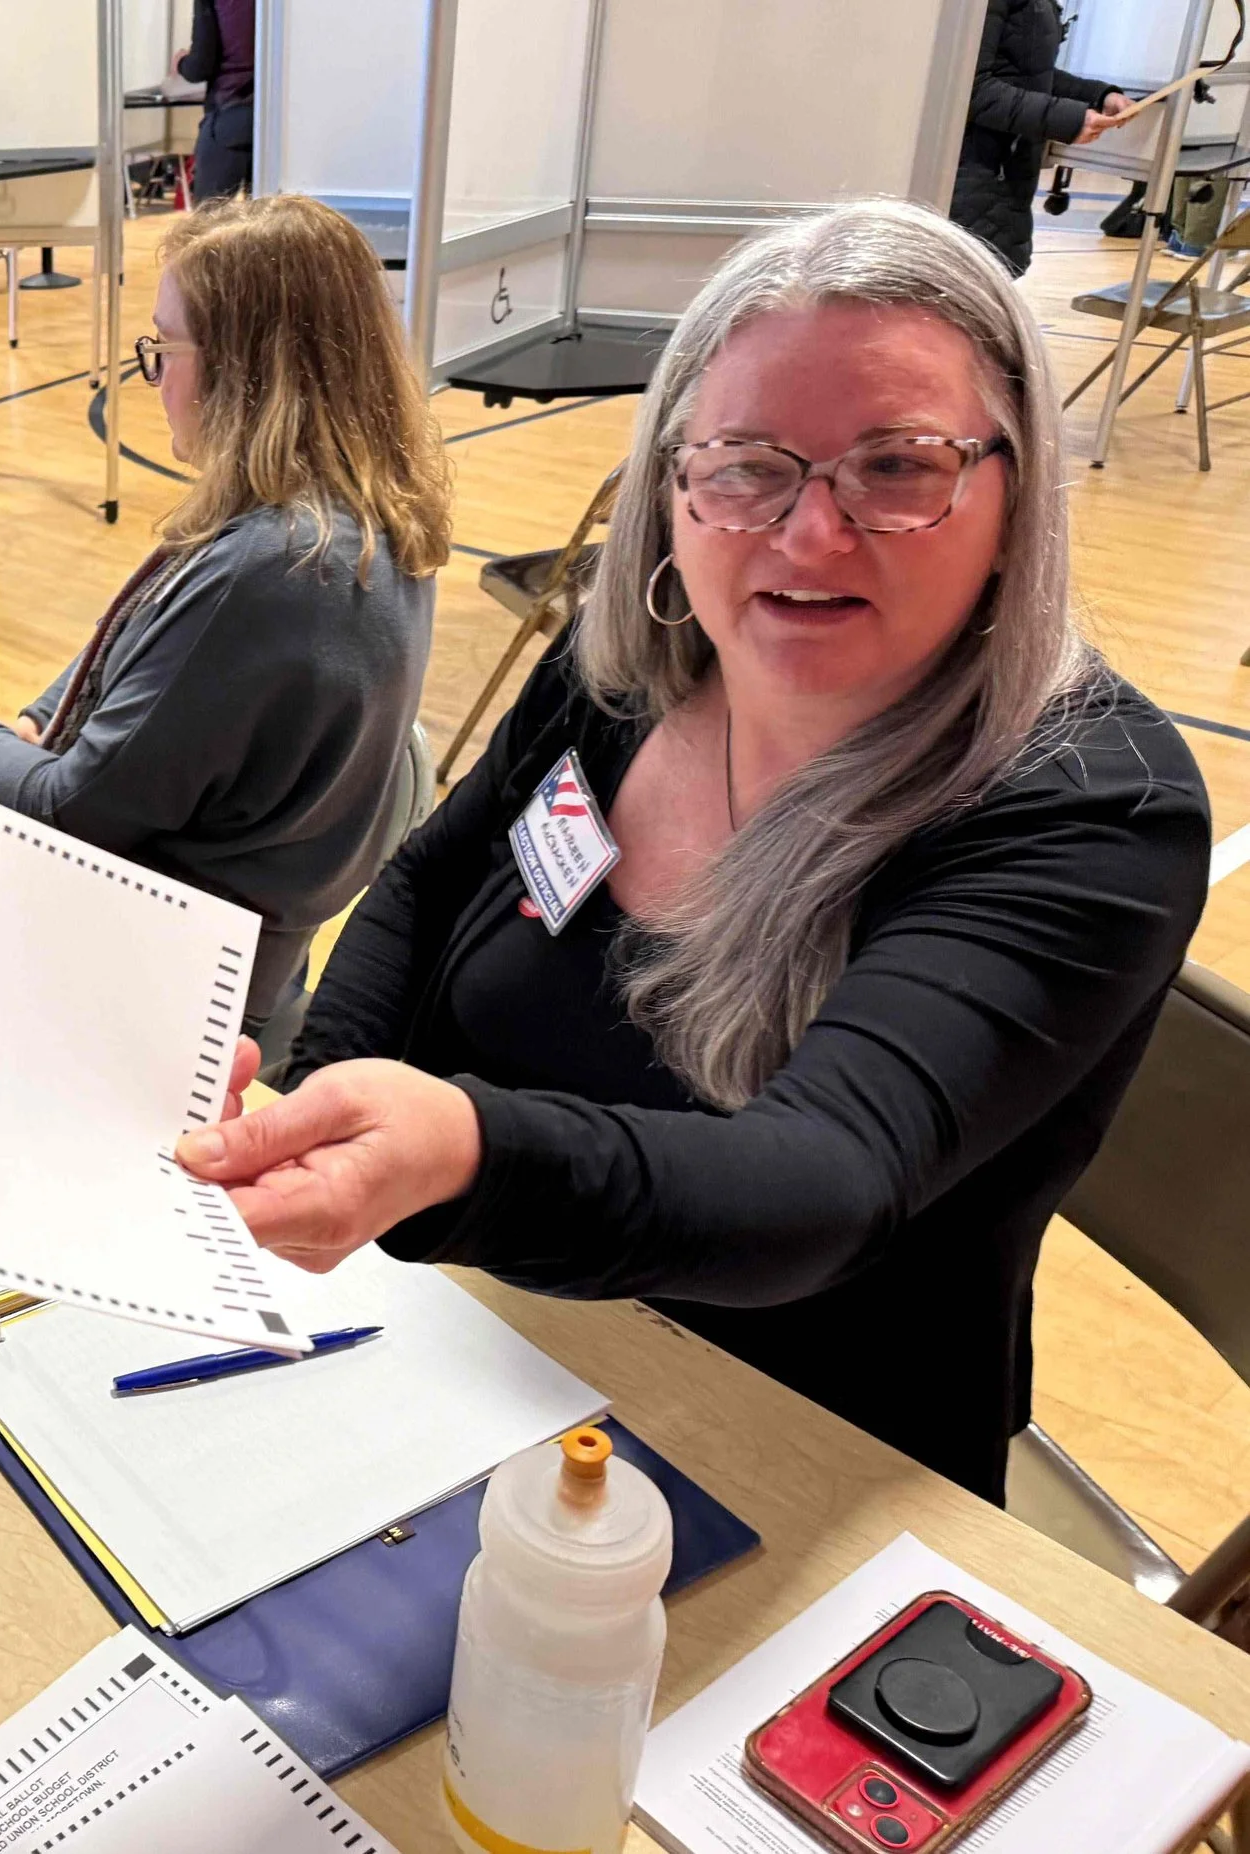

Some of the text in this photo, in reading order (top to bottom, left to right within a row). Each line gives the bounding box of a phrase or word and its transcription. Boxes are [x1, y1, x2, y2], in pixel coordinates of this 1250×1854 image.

[516, 819, 539, 869] ELECTION
[533, 868, 562, 919] OFFICIAL
[6, 1778, 46, 1811] BALLOT
[6, 1815, 40, 1842] UNION
[38, 1785, 80, 1817] SCHOOL
[77, 1749, 120, 1786] DISTRICT
[32, 1771, 72, 1806] BUDGET
